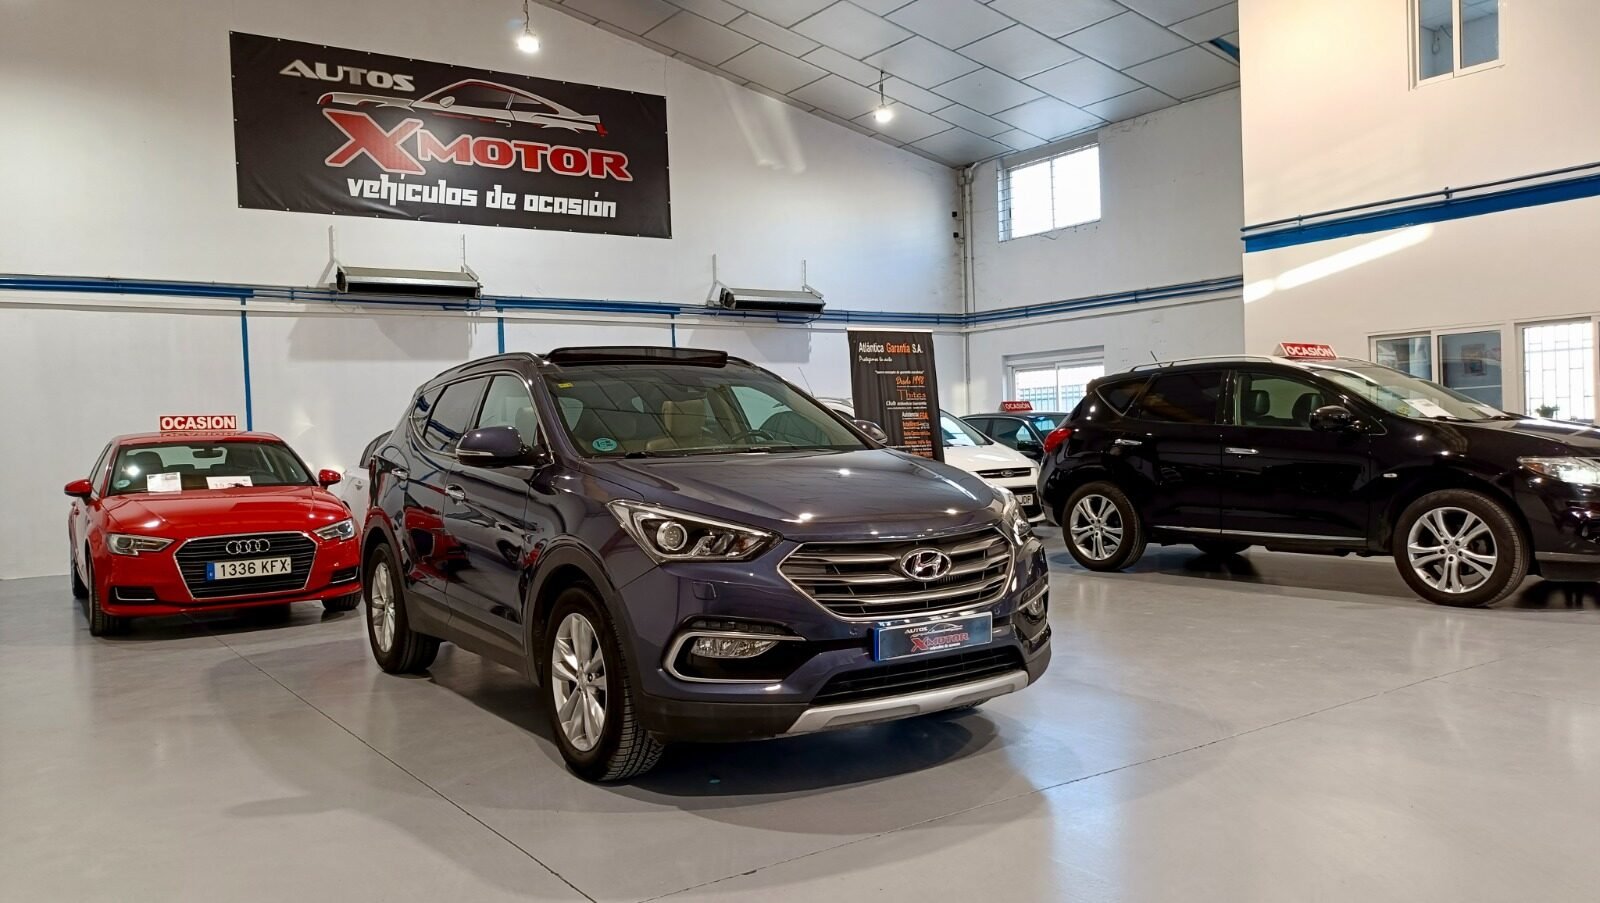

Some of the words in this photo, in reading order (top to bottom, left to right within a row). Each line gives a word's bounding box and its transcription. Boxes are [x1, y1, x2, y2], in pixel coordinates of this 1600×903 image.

[279, 59, 415, 92] AUTOS
[347, 174, 478, 207] vehículos
[485, 184, 517, 211] de
[524, 192, 617, 218] ocasión
[858, 341, 884, 353] Atlántica
[886, 342, 911, 354] Garantía
[912, 343, 924, 354] S.A.
[1286, 345, 1334, 357] OCASIÓN
[161, 416, 236, 430] OCASION
[220, 562, 256, 577] 1336
[261, 559, 288, 574] KFX
[904, 626, 928, 634] AUTOS
